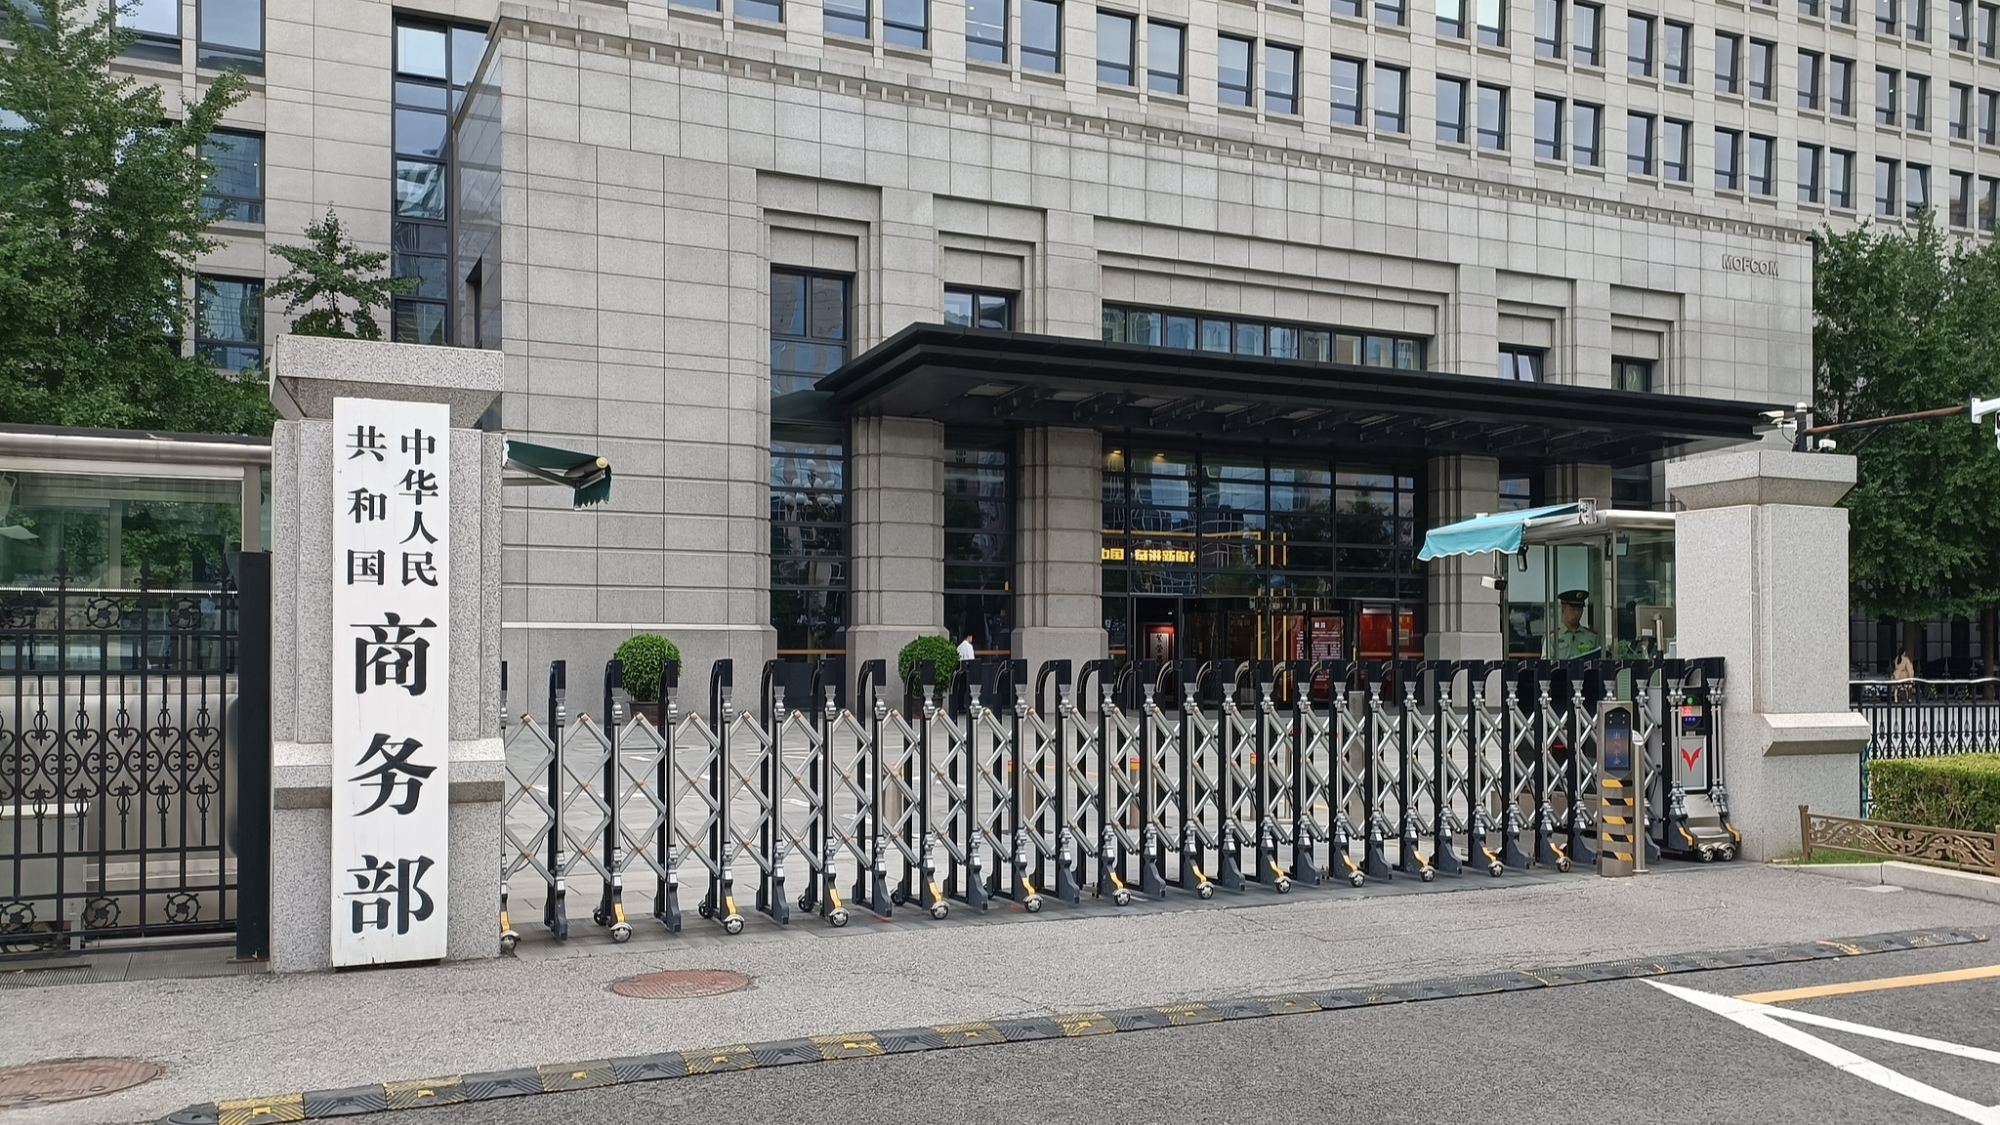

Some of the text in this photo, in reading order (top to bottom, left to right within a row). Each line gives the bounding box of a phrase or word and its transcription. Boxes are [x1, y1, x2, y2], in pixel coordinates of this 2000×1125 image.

[1722, 254, 1779, 277] MOFCOM
[346, 425, 387, 586] 共和国
[398, 427, 439, 587] 中华人民
[342, 611, 438, 936] 商务部
